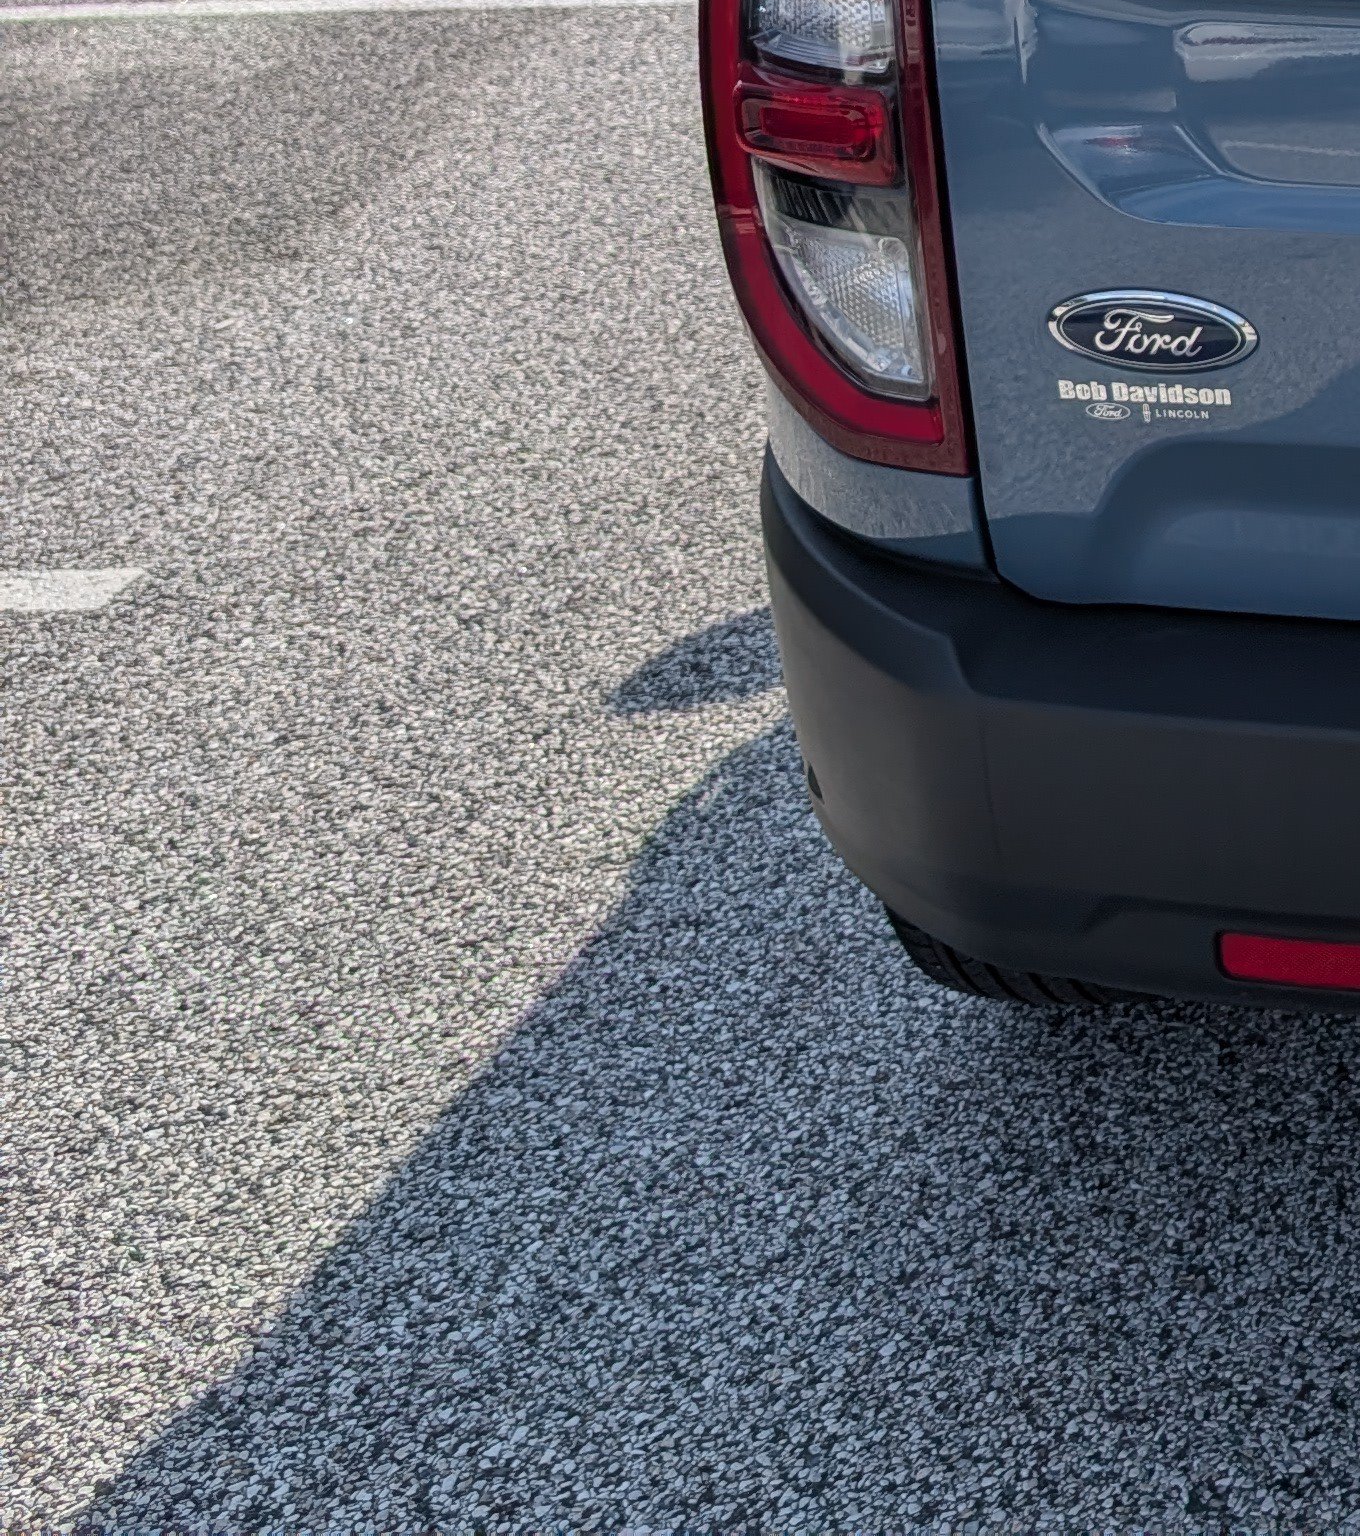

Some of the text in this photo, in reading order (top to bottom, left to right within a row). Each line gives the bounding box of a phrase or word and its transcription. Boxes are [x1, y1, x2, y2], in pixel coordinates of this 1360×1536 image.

[1095, 308, 1203, 357] Ford
[1058, 380, 1231, 405] Bob Davidson
[1093, 404, 1209, 419] Ford LINCOLN
